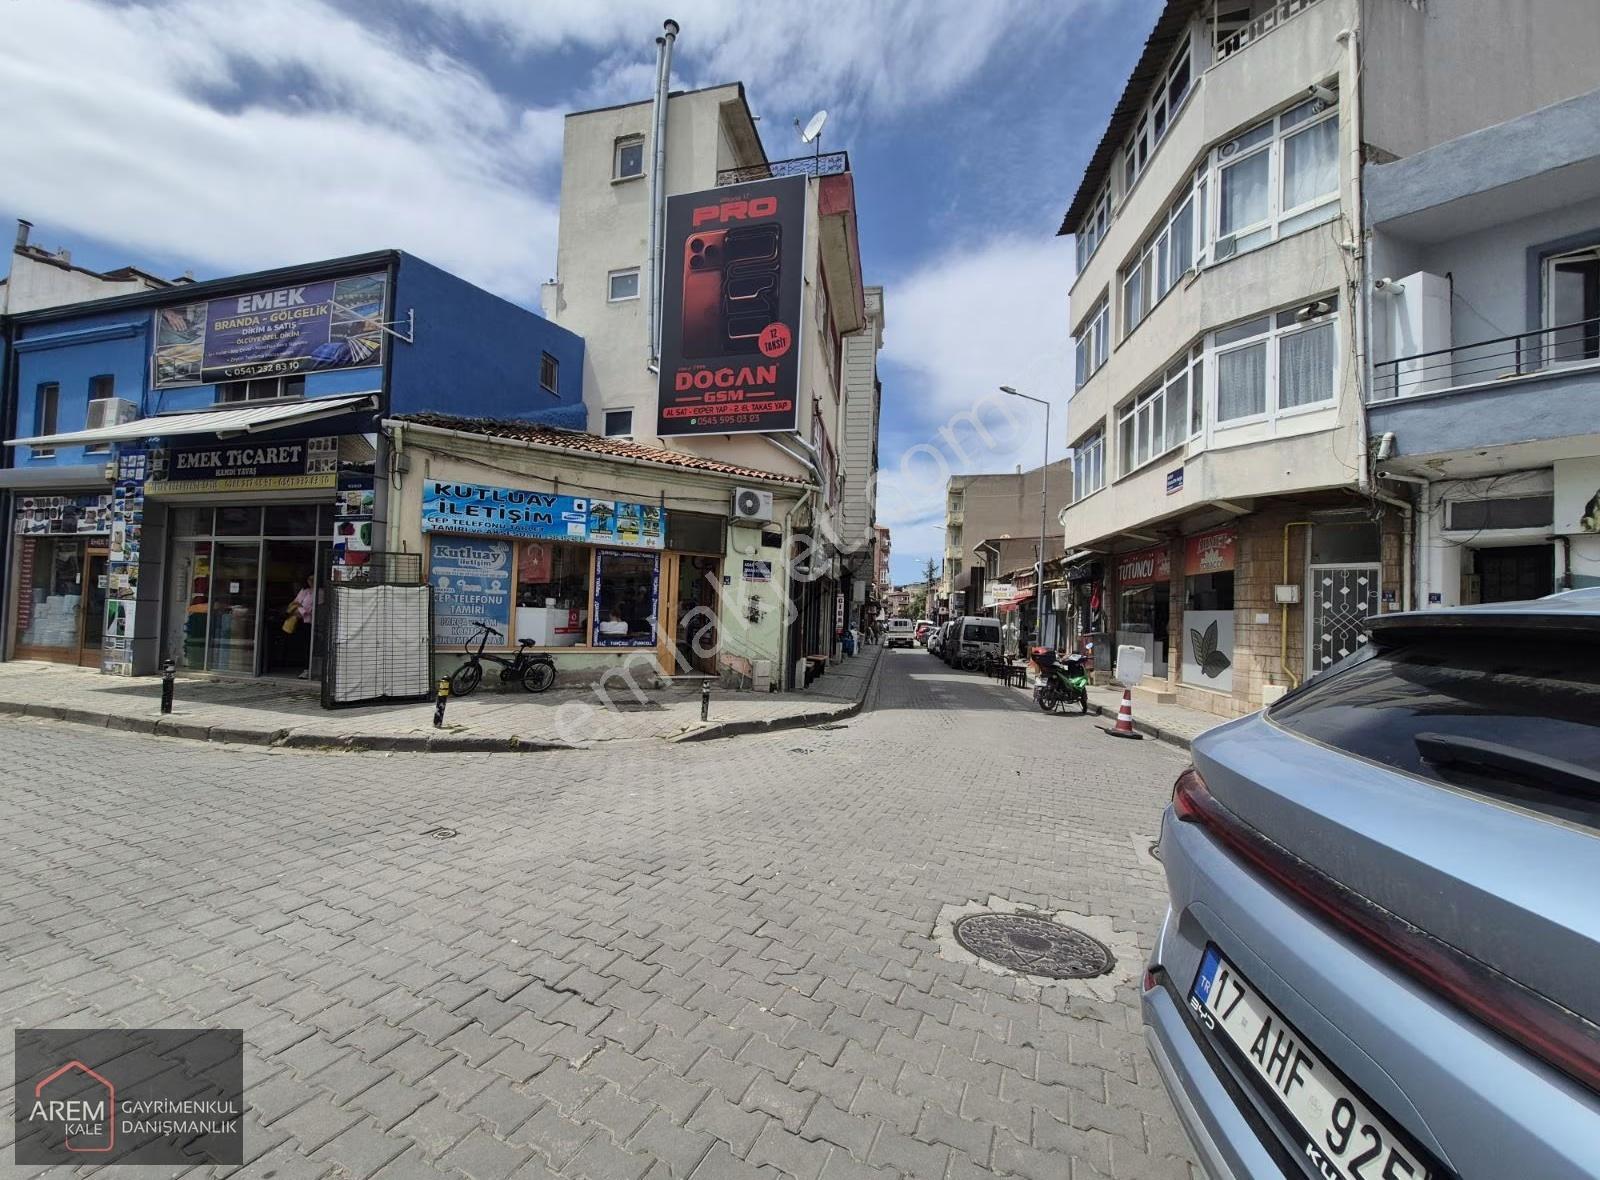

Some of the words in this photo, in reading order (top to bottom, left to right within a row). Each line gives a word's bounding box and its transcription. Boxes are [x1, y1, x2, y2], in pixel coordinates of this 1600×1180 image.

[693, 196, 777, 226] PRO
[237, 286, 306, 314] EMEK
[214, 316, 260, 331] BRANDA
[270, 304, 328, 322] GÖLGELİK
[242, 324, 266, 336] DİKİM
[274, 321, 297, 331] SATIŞ
[770, 328, 777, 338] 12
[234, 366, 254, 376] 0541
[289, 361, 300, 370] 10
[704, 390, 744, 402] GSM
[676, 408, 687, 416] SAT
[716, 405, 728, 414] YAP
[774, 402, 788, 410] YAP
[176, 451, 223, 469] EMEK
[434, 482, 558, 508] KUTLUAY
[439, 498, 553, 524] İLETİŞİM
[452, 518, 506, 529] TELEFONU
[434, 545, 501, 563] Kutluay
[1118, 552, 1154, 580] TÜTÜNCÜ
[450, 603, 485, 614] TAMİRİ
[454, 594, 503, 605] TELEFONU
[1201, 975, 1210, 994] TR
[1214, 970, 1246, 1021] 17
[1250, 1016, 1314, 1096] AHF
